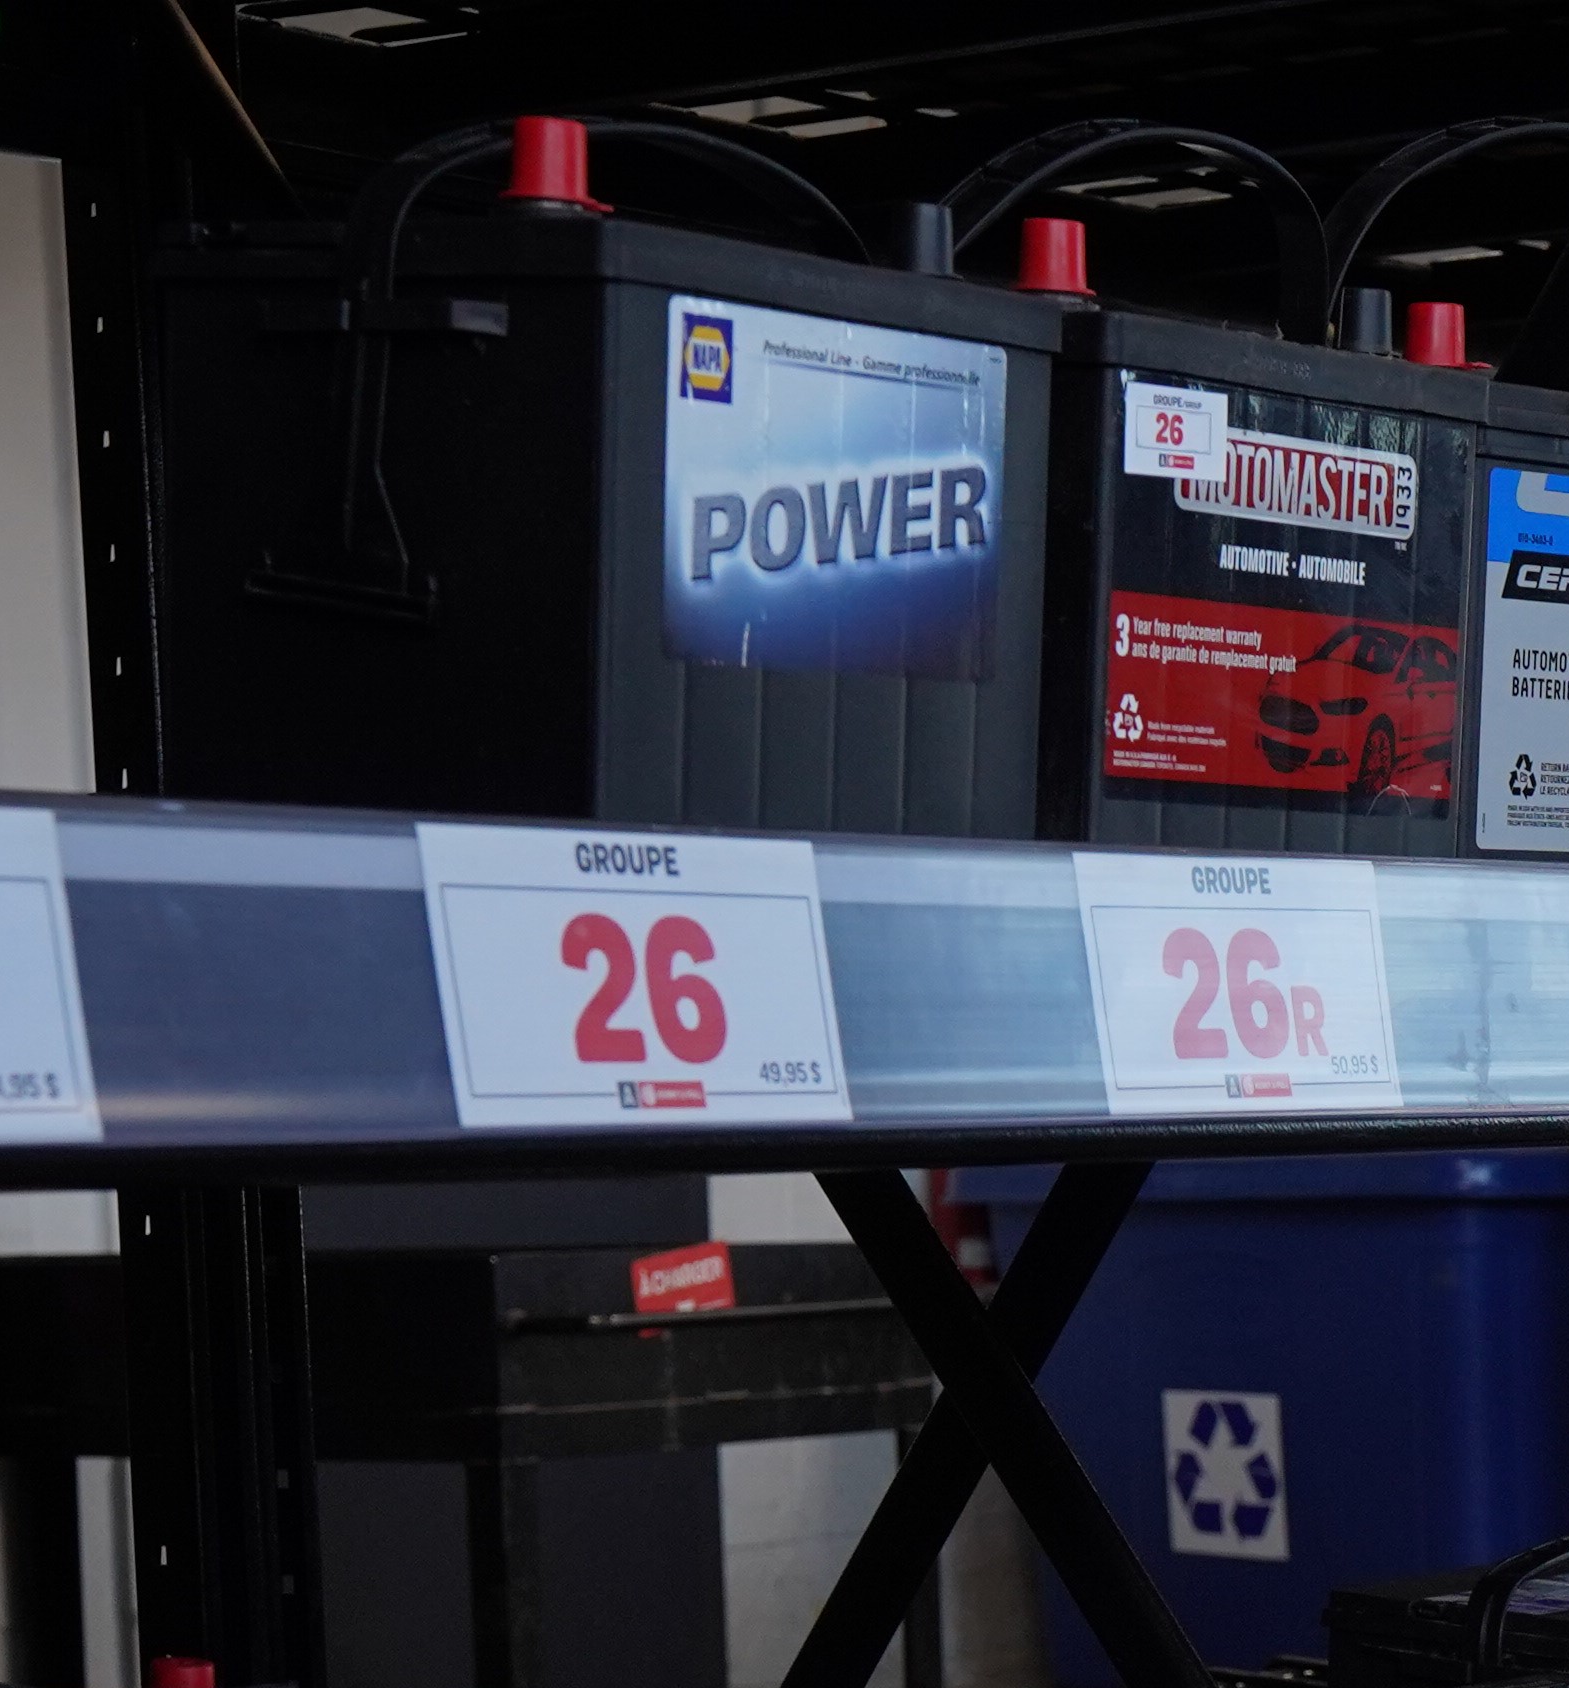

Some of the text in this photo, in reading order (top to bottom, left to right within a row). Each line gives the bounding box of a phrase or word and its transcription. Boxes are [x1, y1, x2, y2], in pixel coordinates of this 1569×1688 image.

[692, 344, 723, 373] NAPA
[763, 340, 828, 363] Professional
[1156, 412, 1183, 445] 26
[1395, 466, 1414, 530] 1933
[692, 466, 987, 581] POWER
[1219, 544, 1366, 586] AUTOMOTIVE AUTOMOBILE
[1115, 613, 1130, 657] 3
[1133, 616, 1262, 651] Year free replacement warranty
[1131, 641, 1297, 675] ans de garantie de remplacement gratuit
[575, 842, 680, 876] GROUPE
[1191, 866, 1271, 895] GROUPE
[561, 913, 727, 1064] 26
[1162, 927, 1329, 1059] 26R
[759, 1061, 822, 1088] 49,95 $
[1331, 1055, 1379, 1076] 50,95 $
